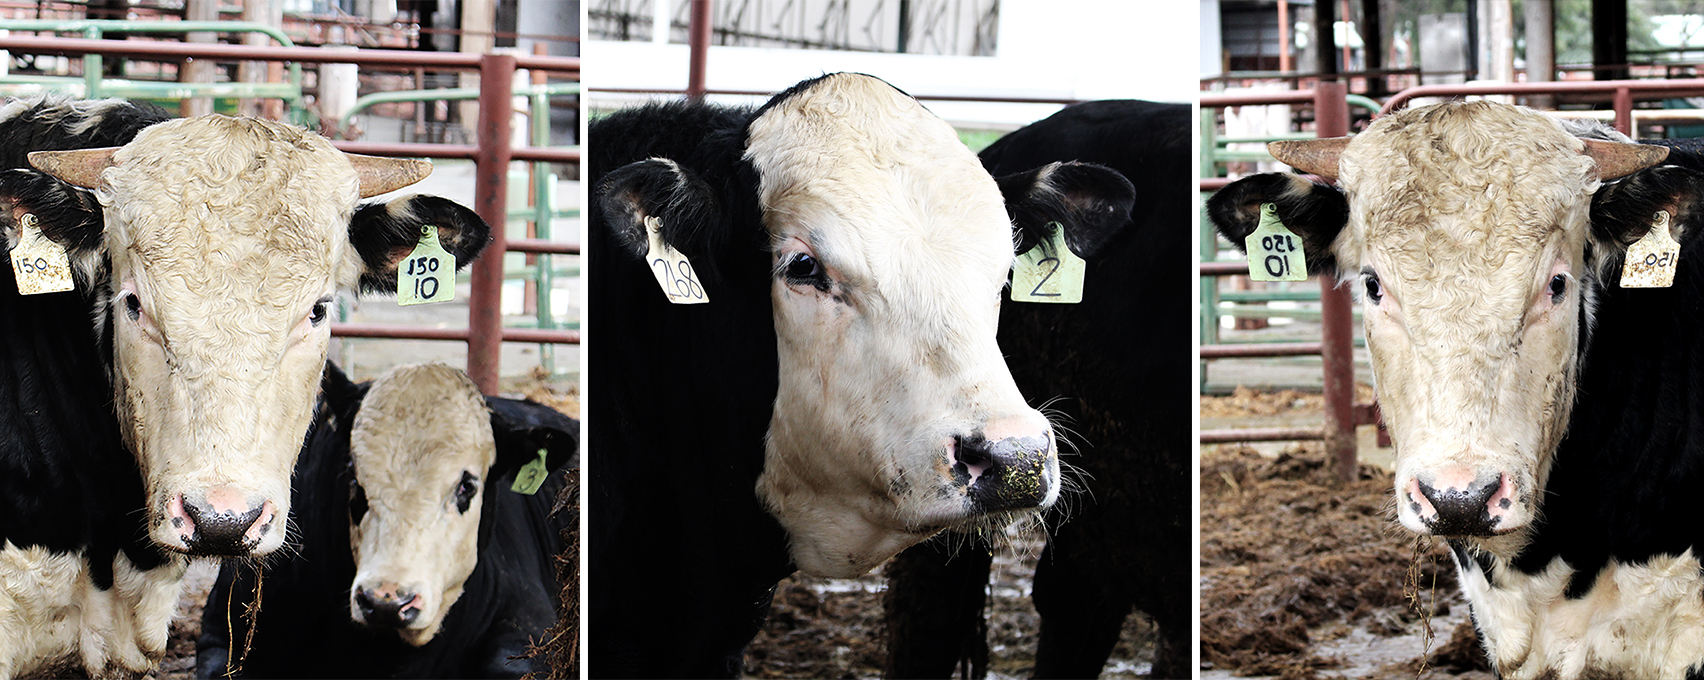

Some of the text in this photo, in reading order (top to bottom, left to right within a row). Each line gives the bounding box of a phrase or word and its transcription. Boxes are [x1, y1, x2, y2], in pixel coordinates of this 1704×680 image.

[16, 257, 48, 274] 150
[407, 257, 439, 276] 150
[1031, 257, 1062, 297] 2
[413, 276, 439, 300] 10
[652, 258, 703, 299] 268
[519, 468, 538, 492] 3
